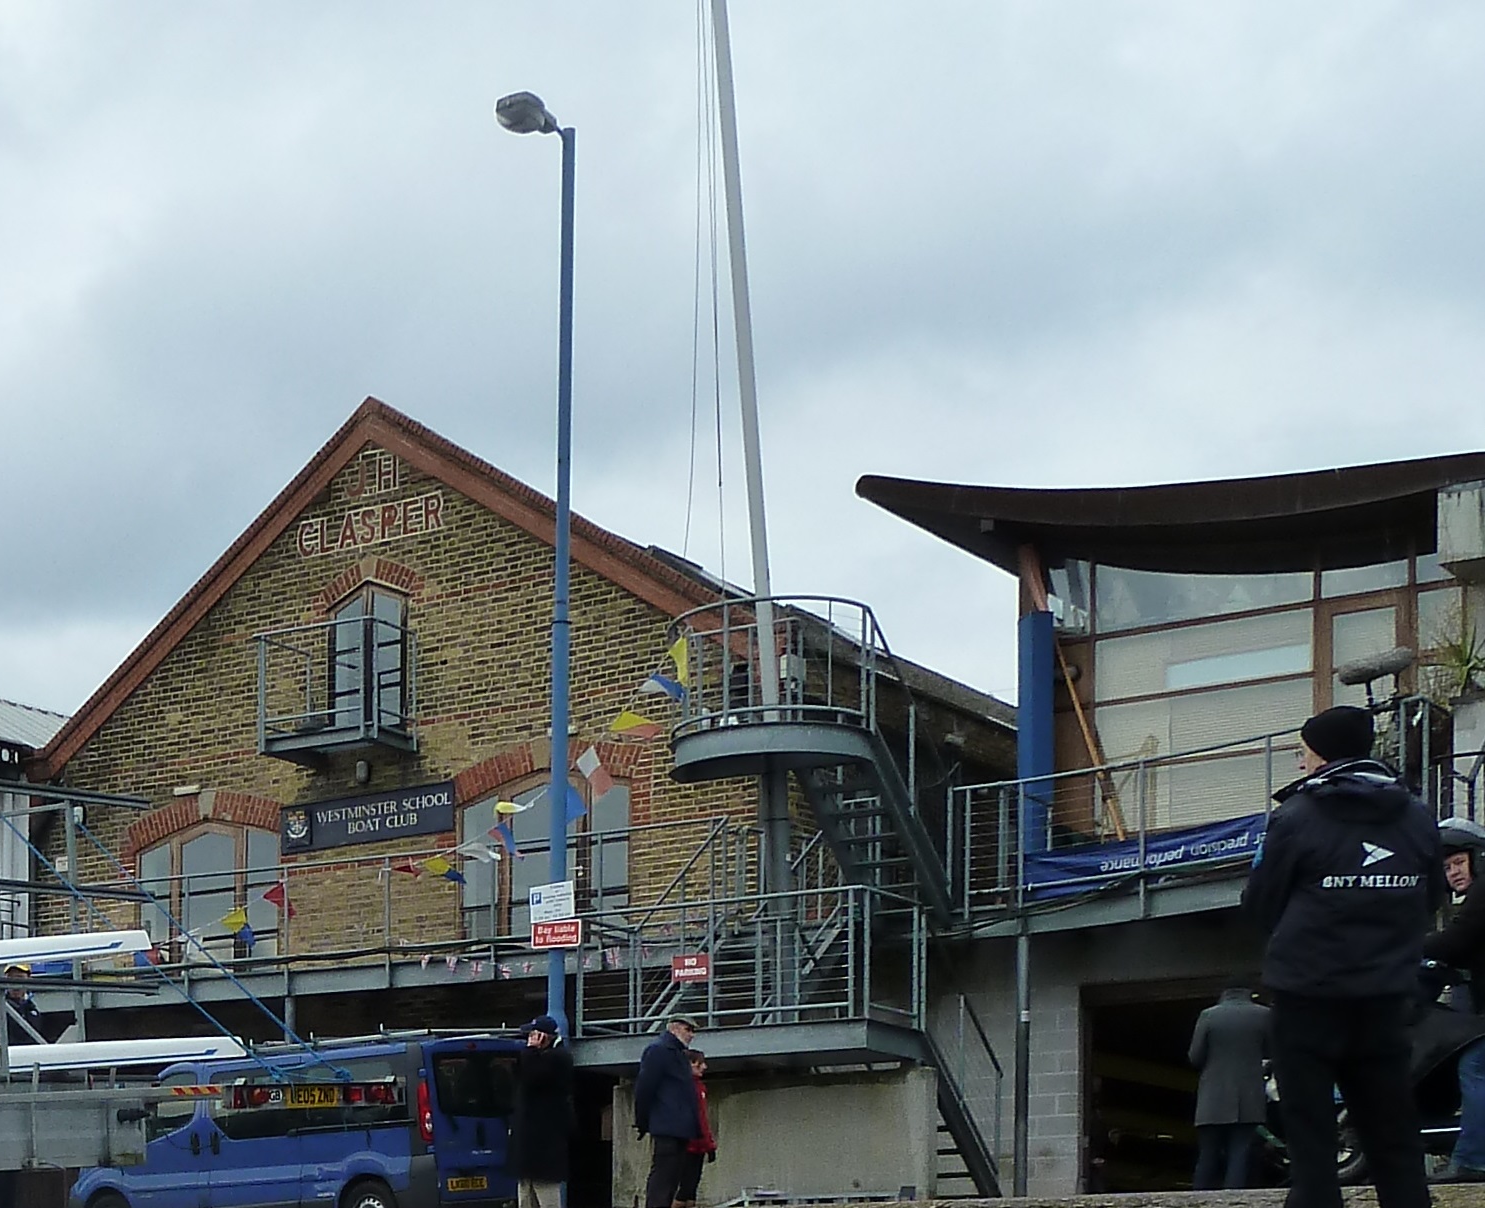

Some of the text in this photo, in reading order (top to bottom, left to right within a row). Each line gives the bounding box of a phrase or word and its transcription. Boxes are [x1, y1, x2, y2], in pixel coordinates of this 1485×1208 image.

[297, 490, 444, 558] CLASPER
[316, 792, 452, 825] WESTMINSTER SCHOOL
[347, 812, 418, 835] BOAT CLUB
[1190, 832, 1249, 856] precision
[1322, 875, 1420, 888] BNY MELLON
[684, 958, 697, 967] NO
